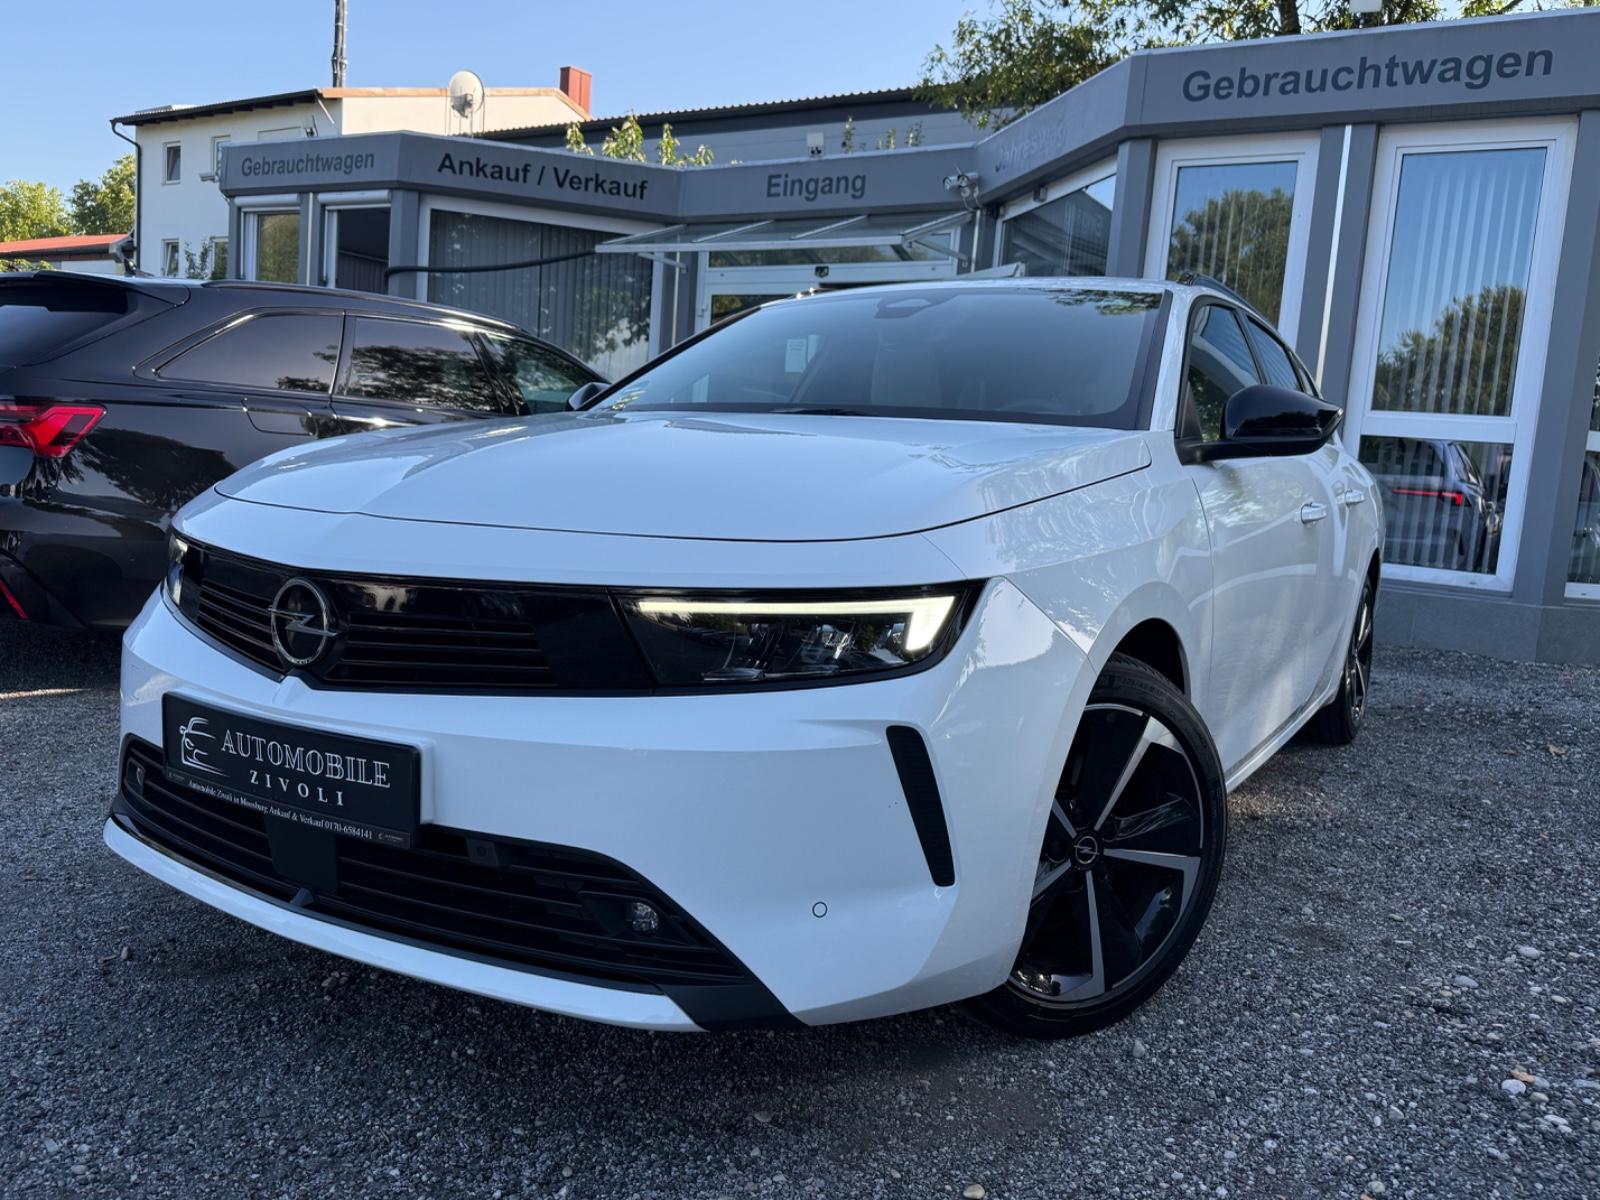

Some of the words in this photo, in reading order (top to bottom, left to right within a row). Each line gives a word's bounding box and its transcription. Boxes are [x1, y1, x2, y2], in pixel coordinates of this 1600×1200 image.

[1182, 49, 1554, 101] Gebrauchtwagen
[241, 151, 375, 177] Gebrauchtwagen
[437, 153, 532, 184] Ankauf
[538, 166, 547, 186] /
[553, 167, 649, 200] Verkauf
[766, 172, 867, 201] Eingang
[221, 729, 391, 789] AUTOMOBILE
[249, 770, 345, 806] ZIVOLI
[269, 806, 291, 819] Ankauf
[292, 811, 298, 821] &
[300, 813, 324, 828] Verkauf
